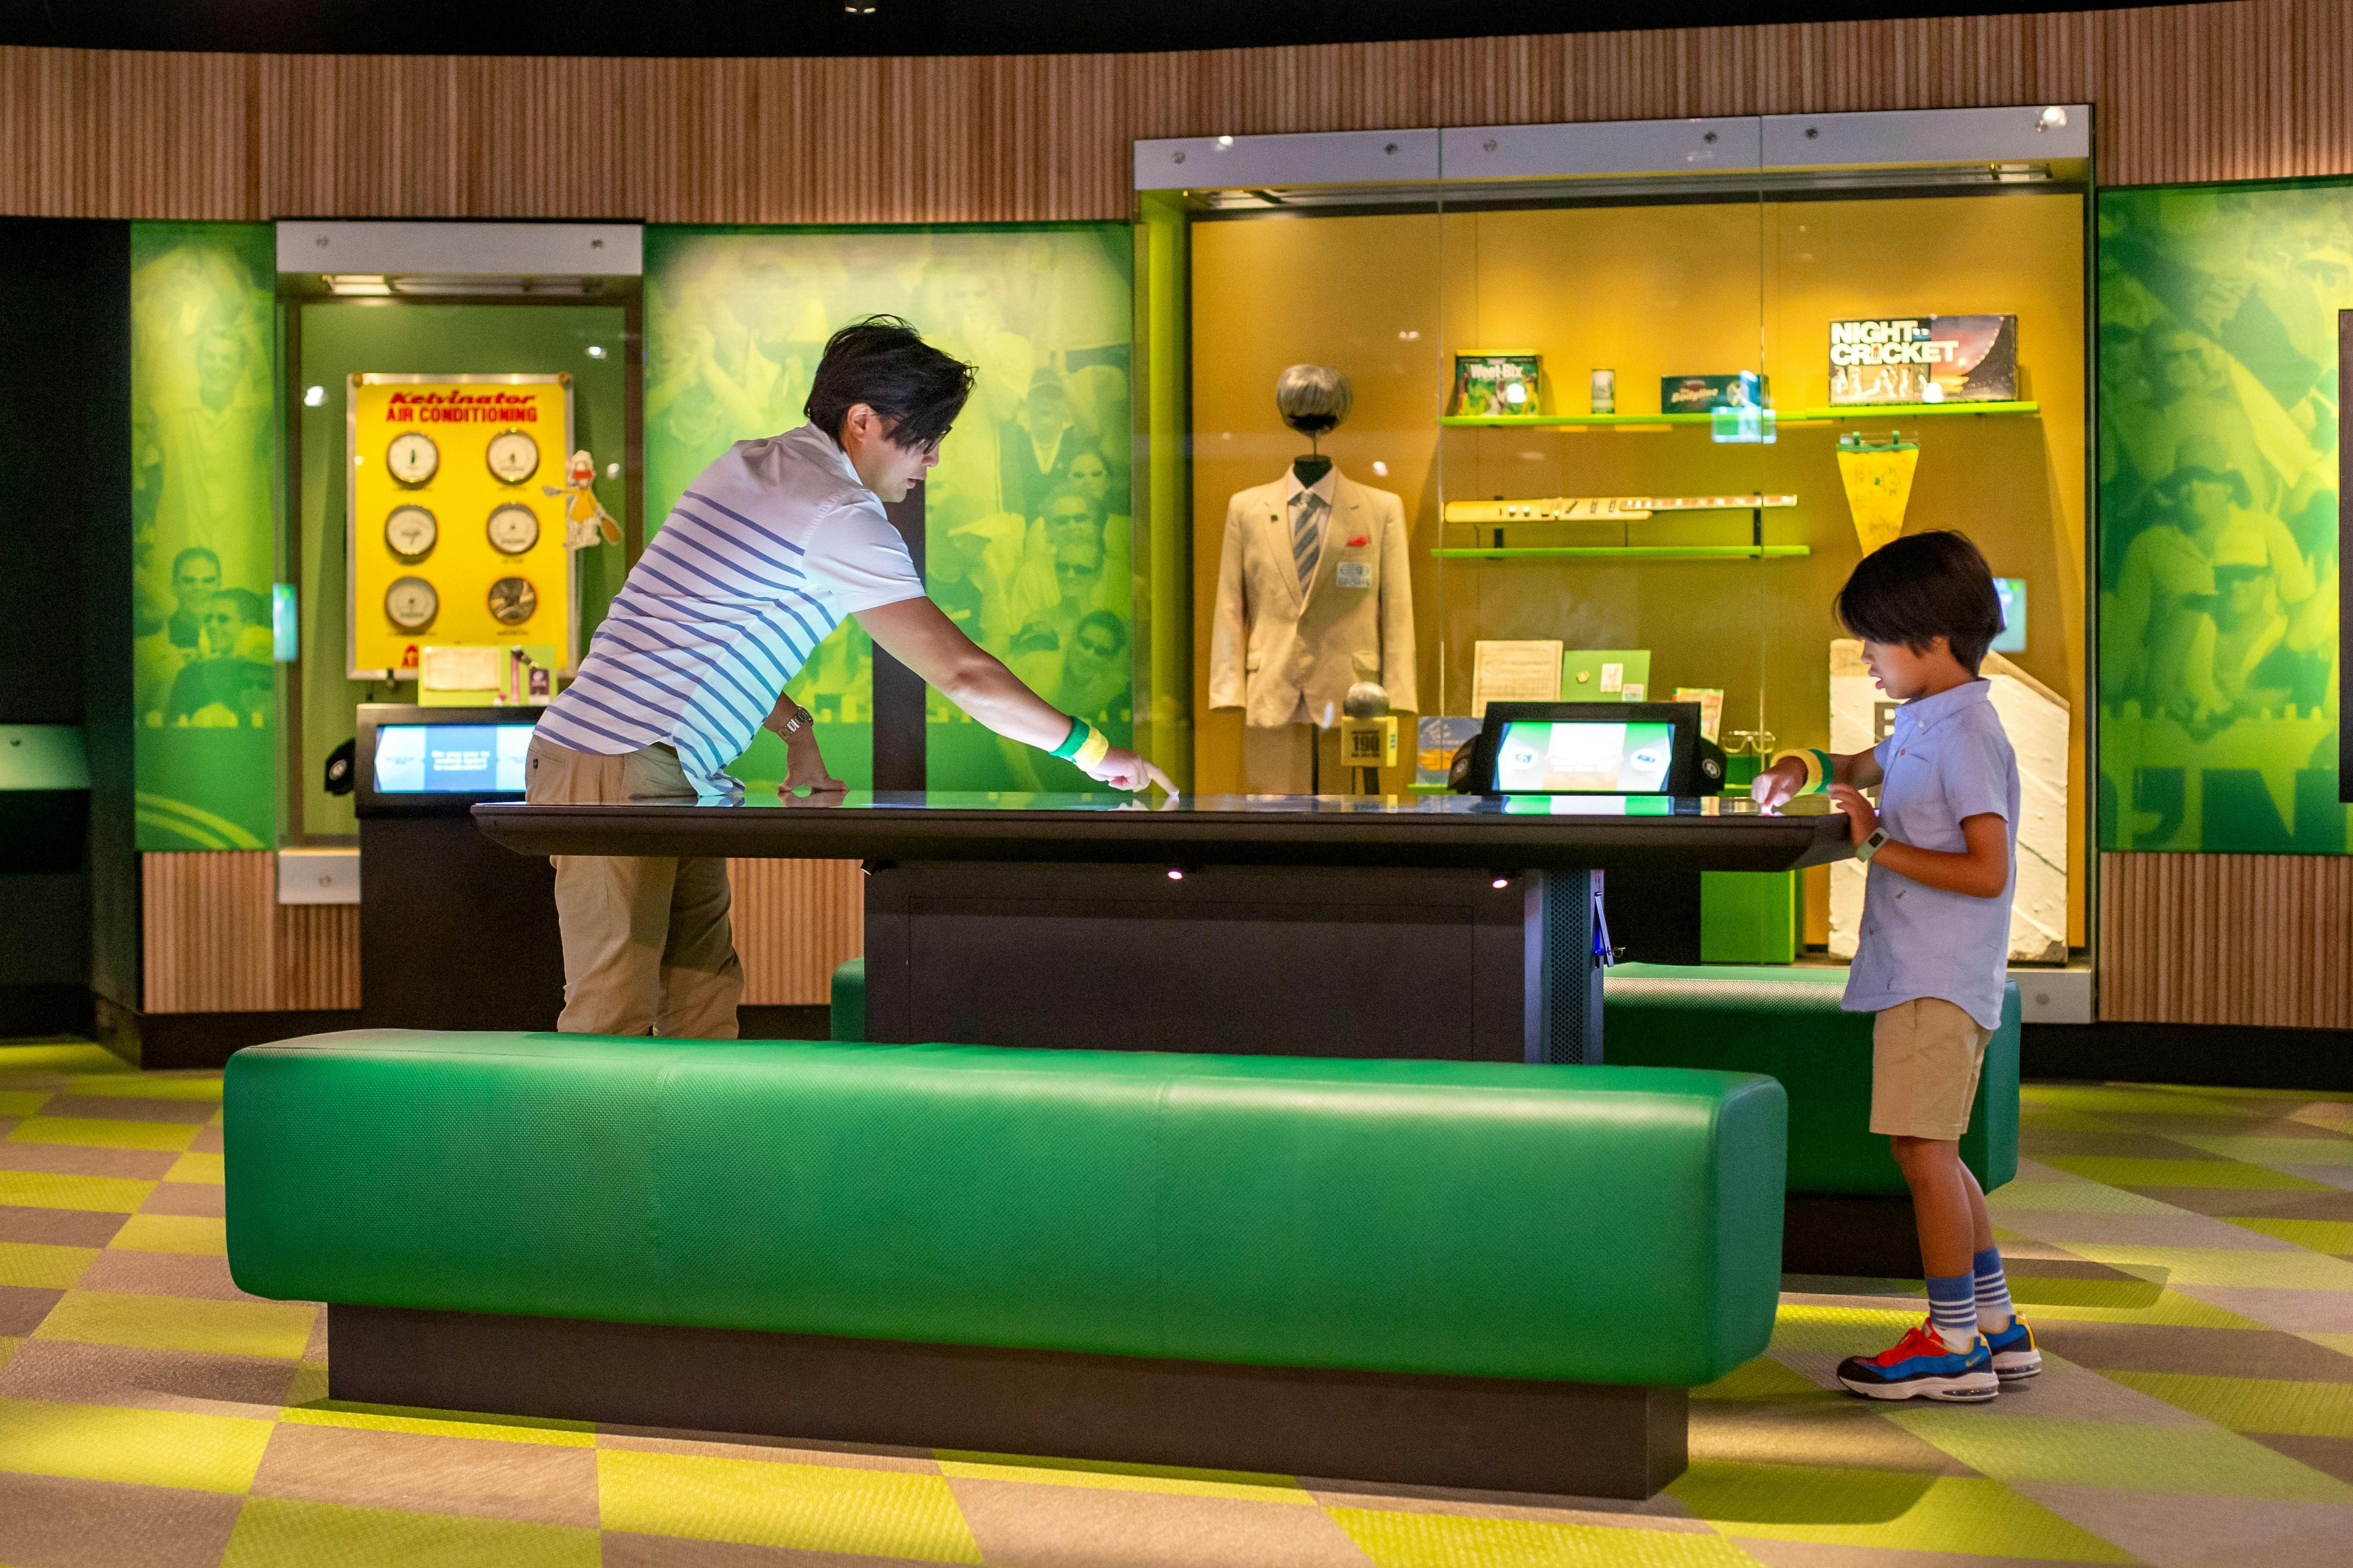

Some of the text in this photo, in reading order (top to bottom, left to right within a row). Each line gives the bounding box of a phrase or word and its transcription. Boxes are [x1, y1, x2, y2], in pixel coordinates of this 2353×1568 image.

[1831, 320, 1918, 343] NIGHT
[1830, 340, 1959, 365] CRICKET
[390, 389, 536, 404] Kelvinator
[386, 407, 537, 423] AIR CONDITIONING
